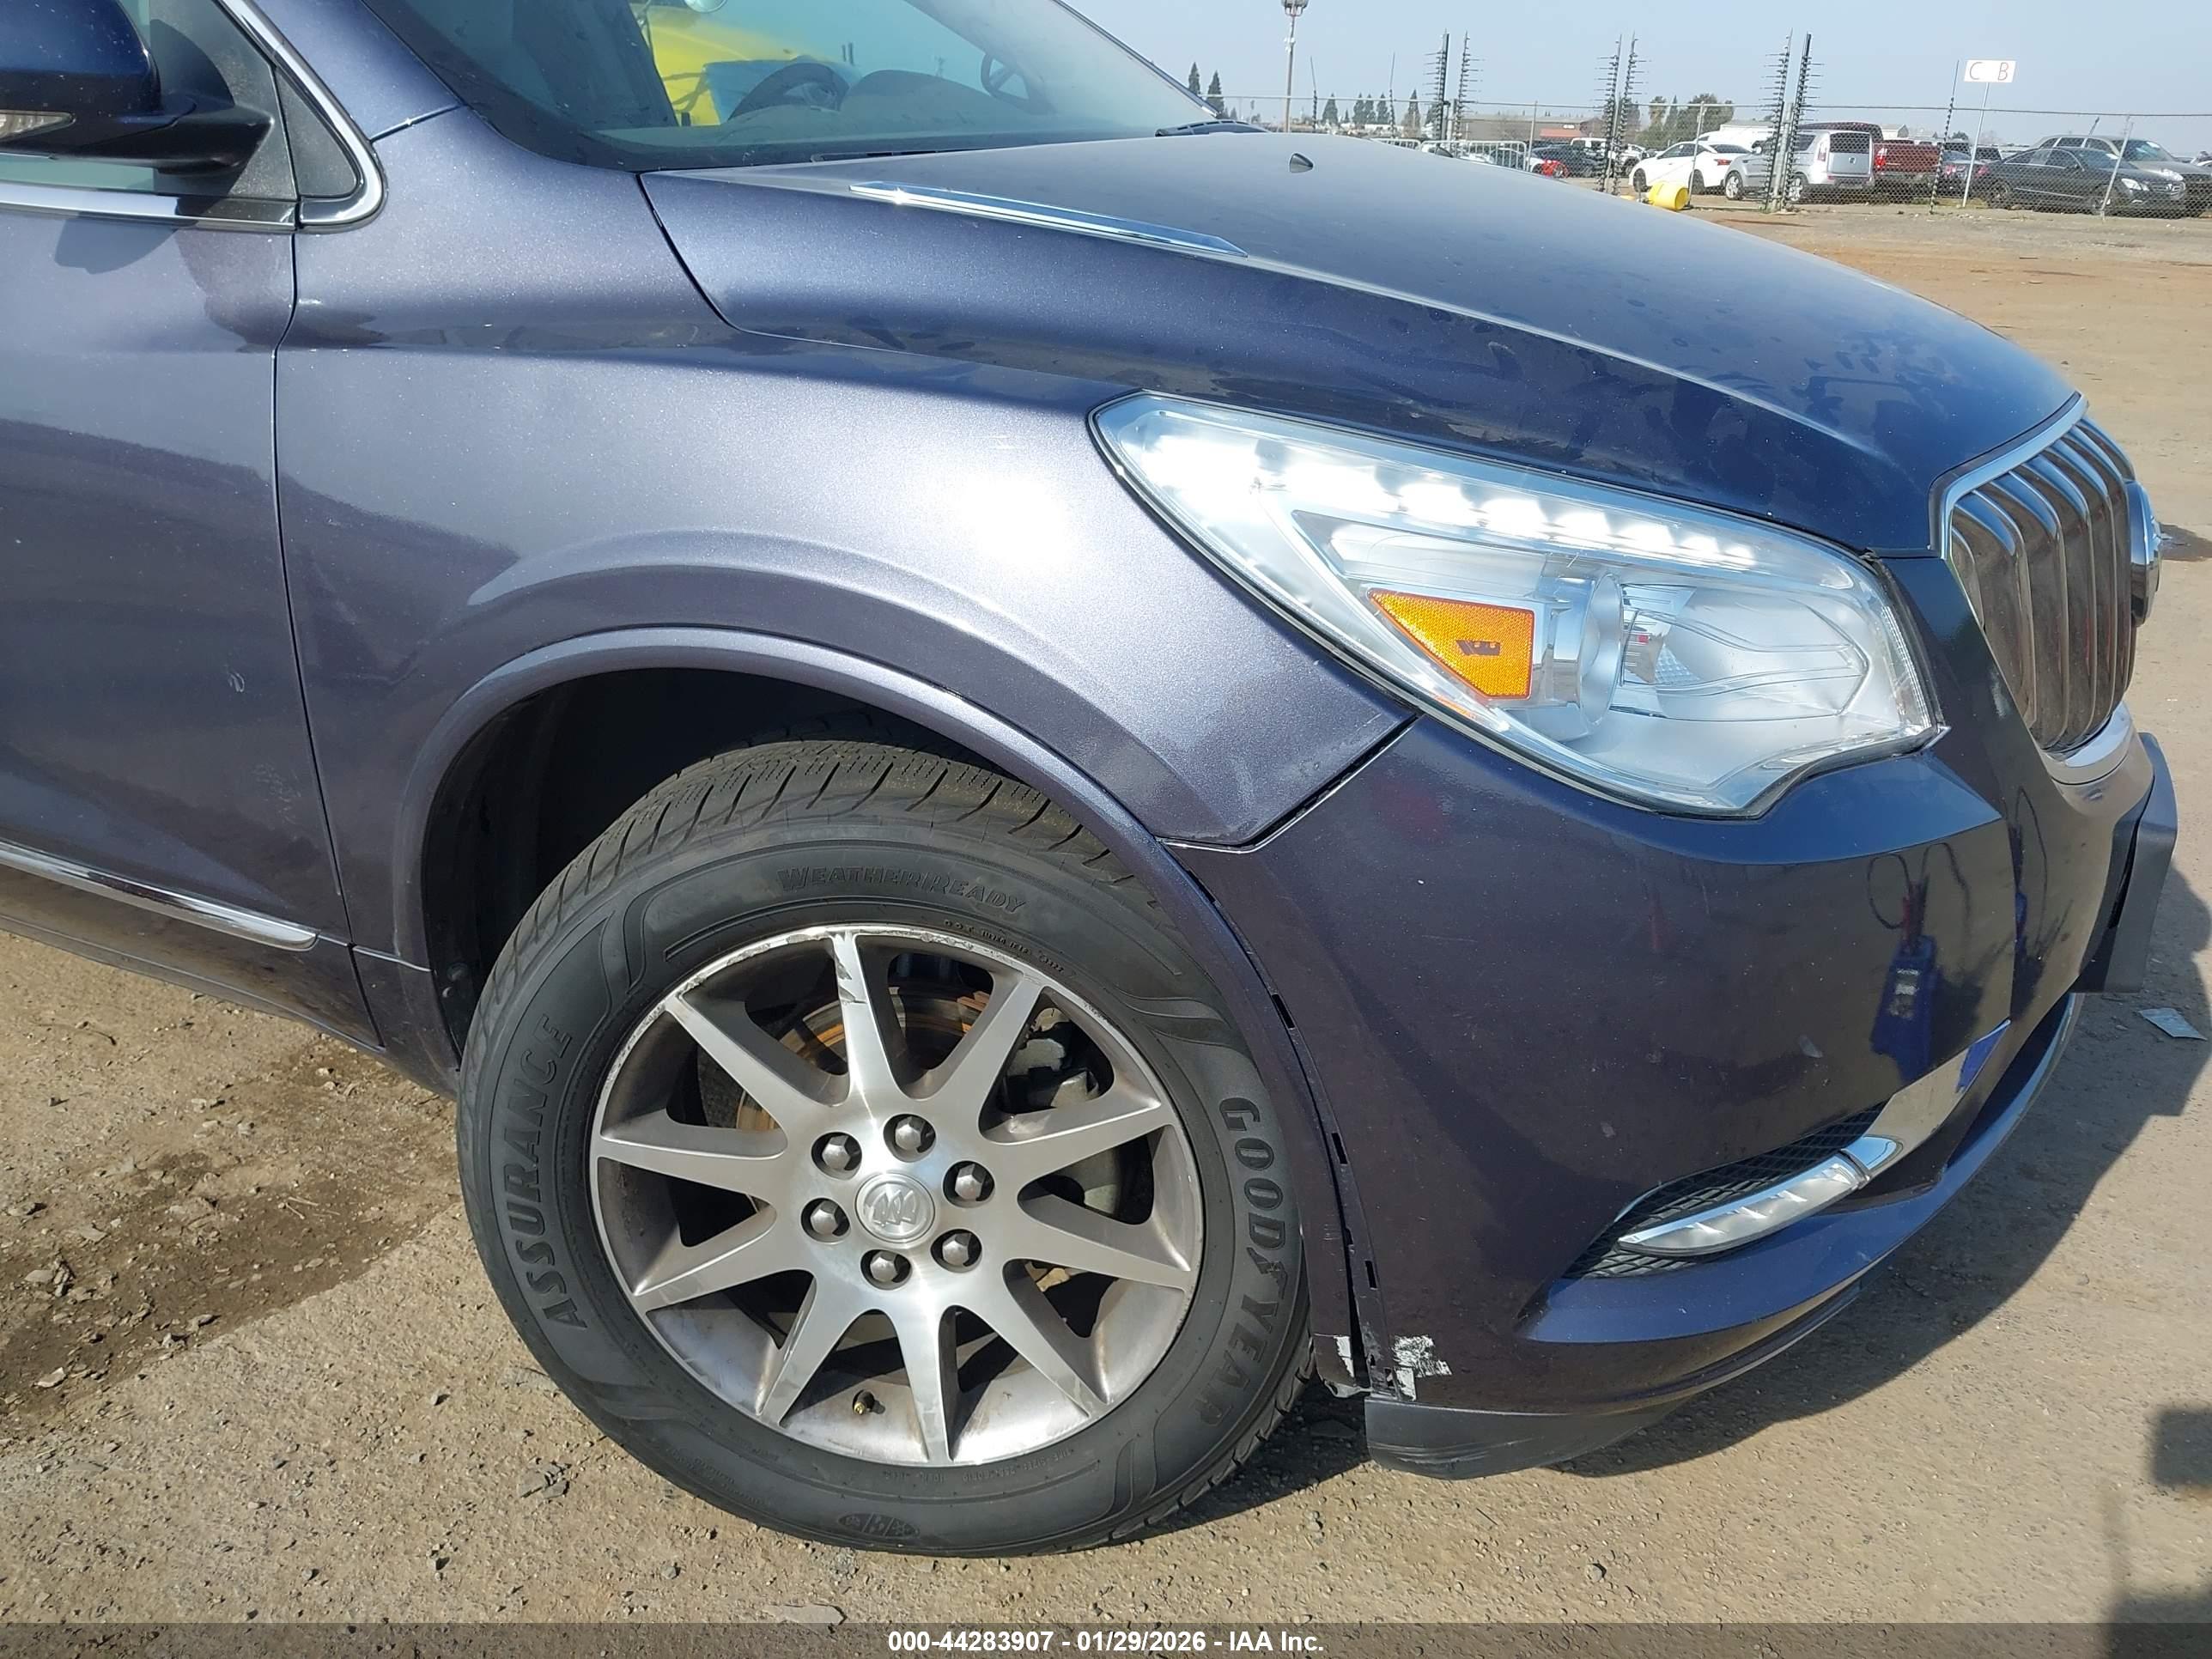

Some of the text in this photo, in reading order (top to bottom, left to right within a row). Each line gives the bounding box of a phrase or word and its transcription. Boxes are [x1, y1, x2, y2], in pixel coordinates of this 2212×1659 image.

[1969, 61, 2009, 81] C B
[503, 1013, 588, 1330] ASSURANCE
